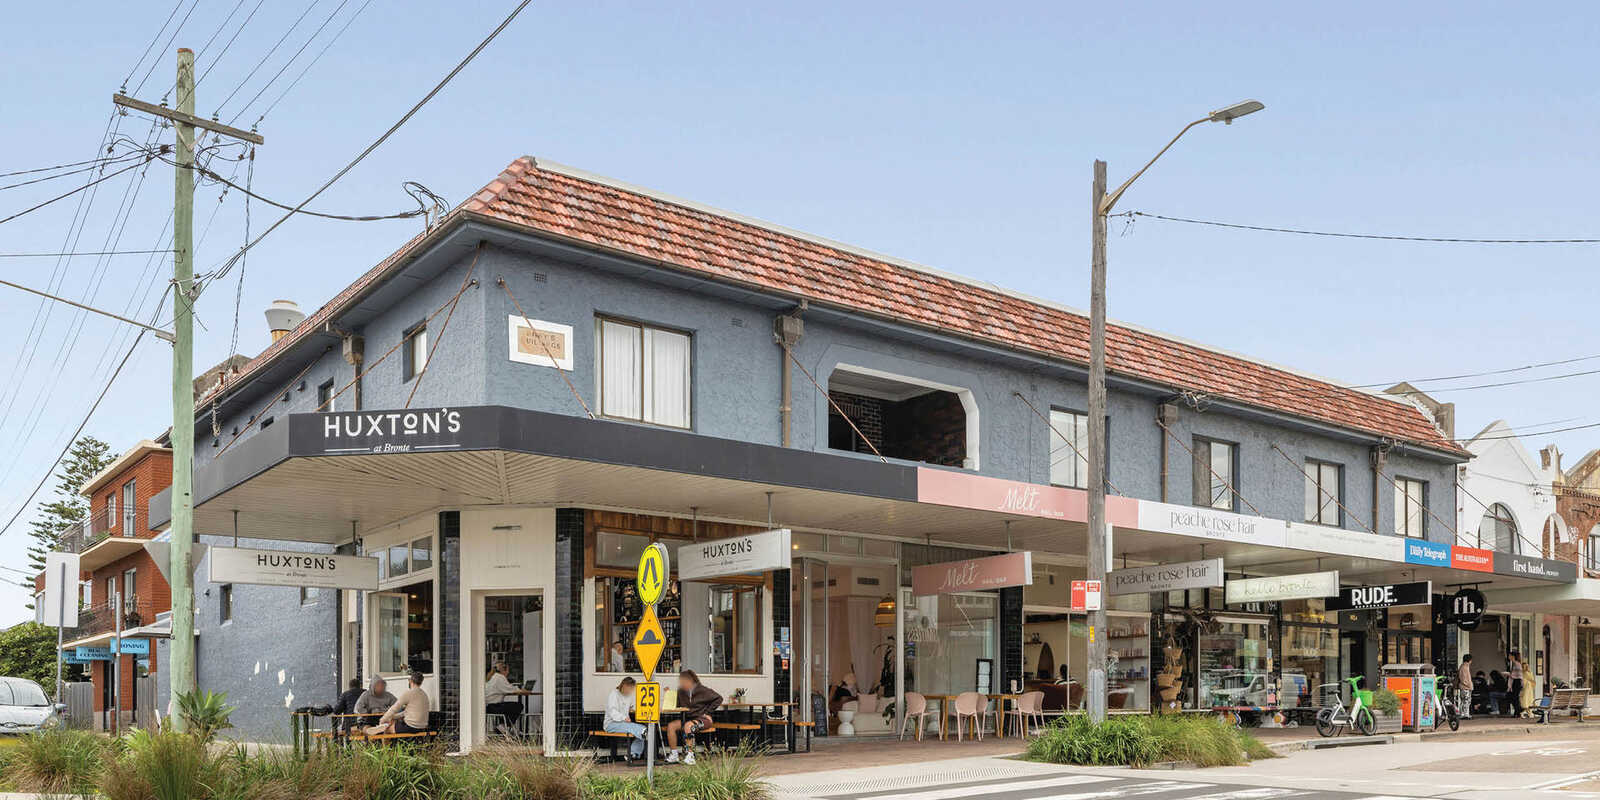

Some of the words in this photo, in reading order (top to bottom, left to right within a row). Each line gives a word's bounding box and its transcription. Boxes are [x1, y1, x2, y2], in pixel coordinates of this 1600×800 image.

[324, 408, 461, 438] HUXTON'S
[384, 443, 410, 453] Bronte
[997, 486, 1040, 511] Melt
[1170, 511, 1209, 529] peache
[1212, 517, 1233, 532] rose
[1237, 517, 1256, 534] hair
[703, 539, 752, 559] HUXTON'S
[1424, 547, 1446, 561] Telegraph
[257, 554, 336, 571] HUXTON'S
[1513, 560, 1526, 573] first
[938, 562, 980, 590] Melt
[1115, 569, 1155, 590] peache
[1158, 564, 1184, 581] rose
[1186, 563, 1209, 578] hair
[1351, 585, 1398, 605] RUDE.
[1454, 596, 1482, 615] fh.
[640, 686, 655, 707] 25
